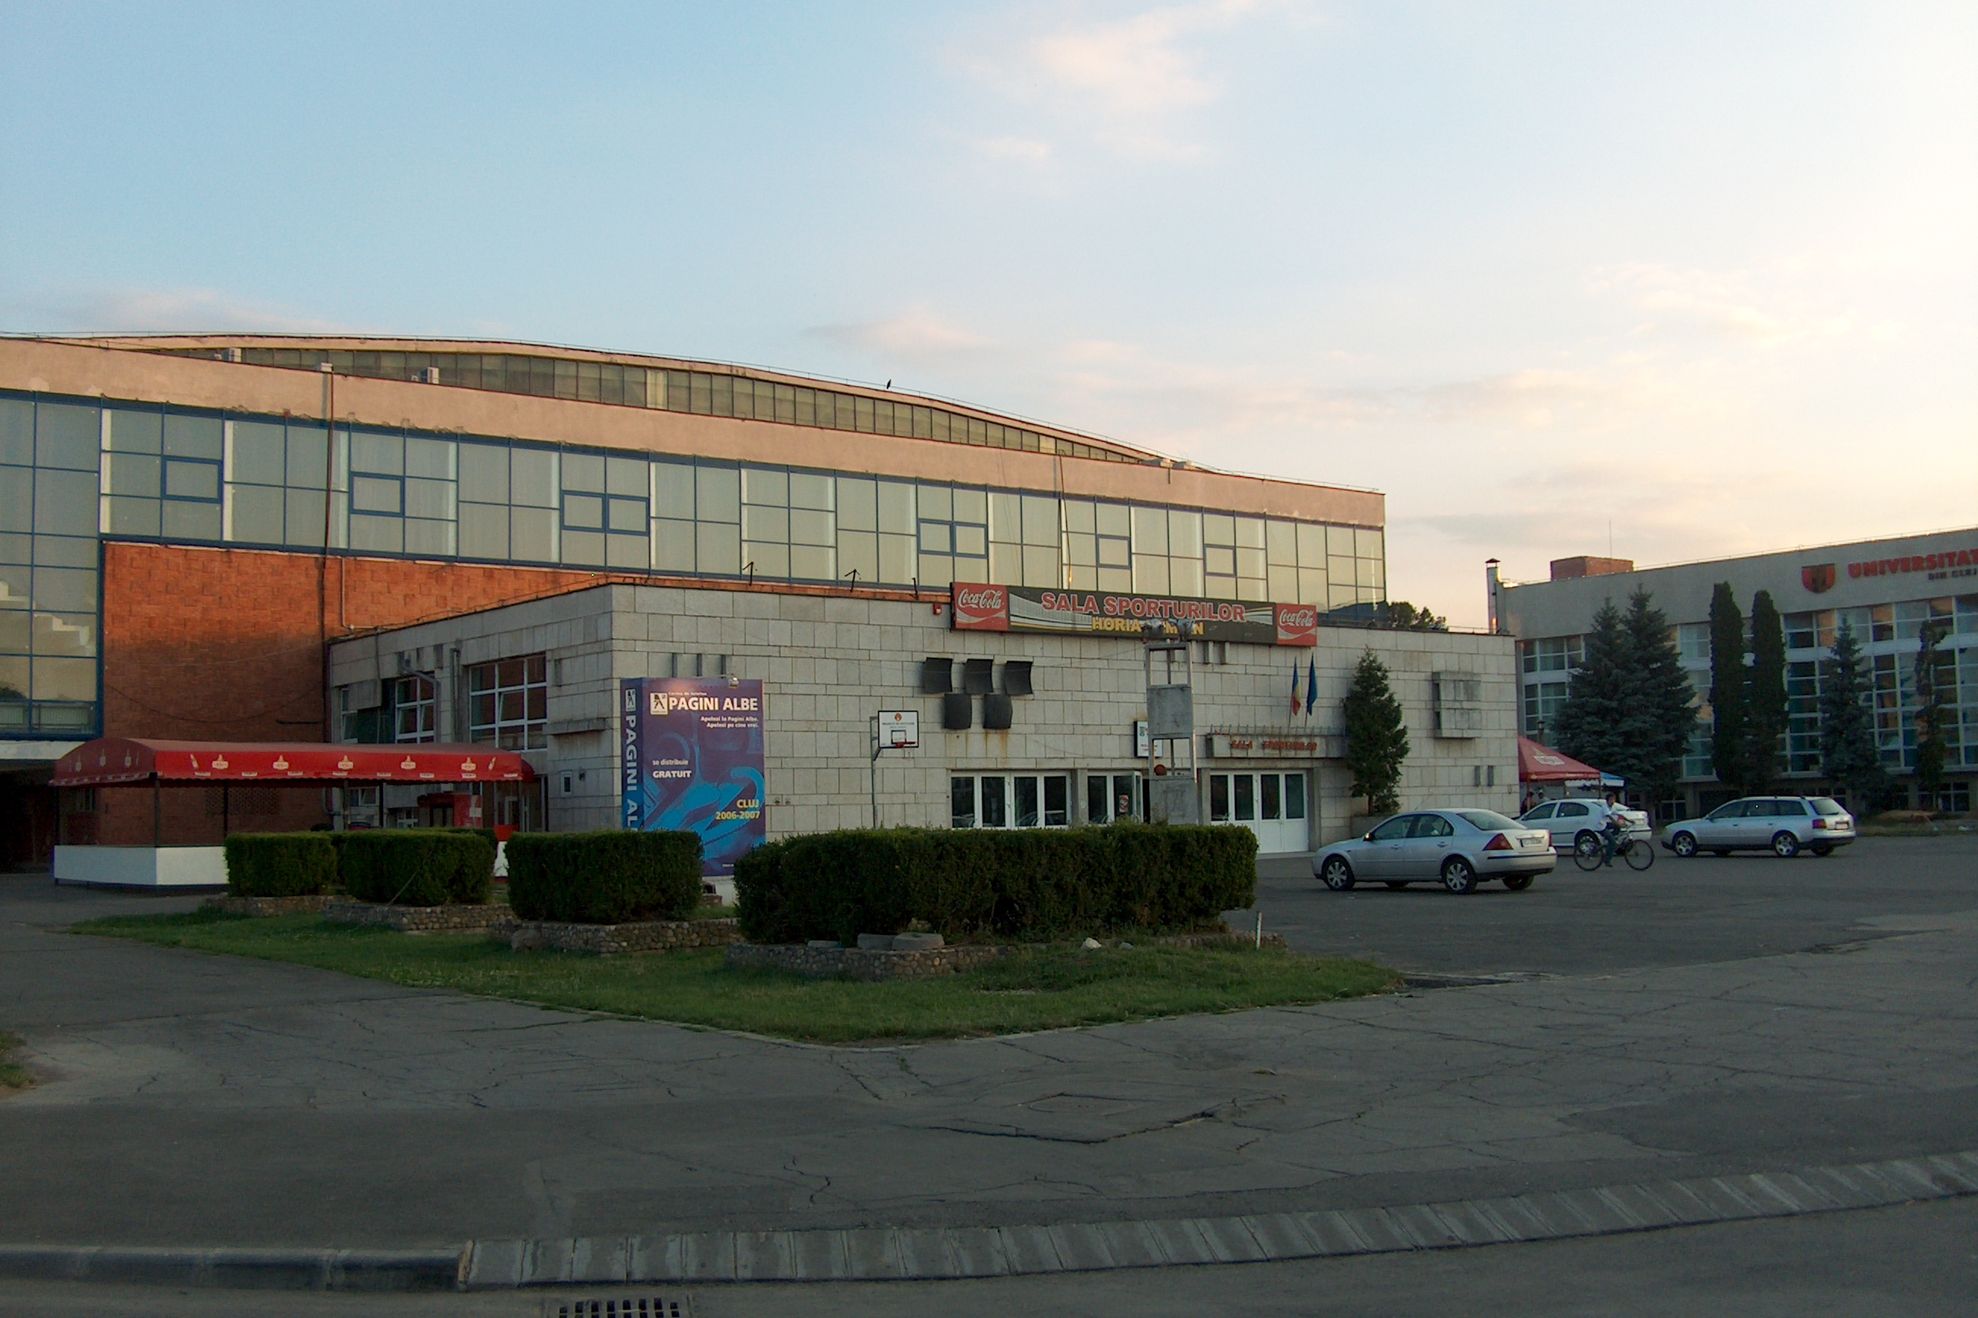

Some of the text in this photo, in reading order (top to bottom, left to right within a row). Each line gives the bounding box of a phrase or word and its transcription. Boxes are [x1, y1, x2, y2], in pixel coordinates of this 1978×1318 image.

[1041, 592, 1246, 622] SALA SPORTURILOR
[1092, 617, 1142, 632] HORIA
[669, 696, 759, 711] PAGINI ALBE
[625, 715, 638, 791] PAGINI
[652, 770, 692, 778] GRATUIT
[736, 799, 760, 809] CLUJ
[715, 811, 760, 820] 2006-2007
